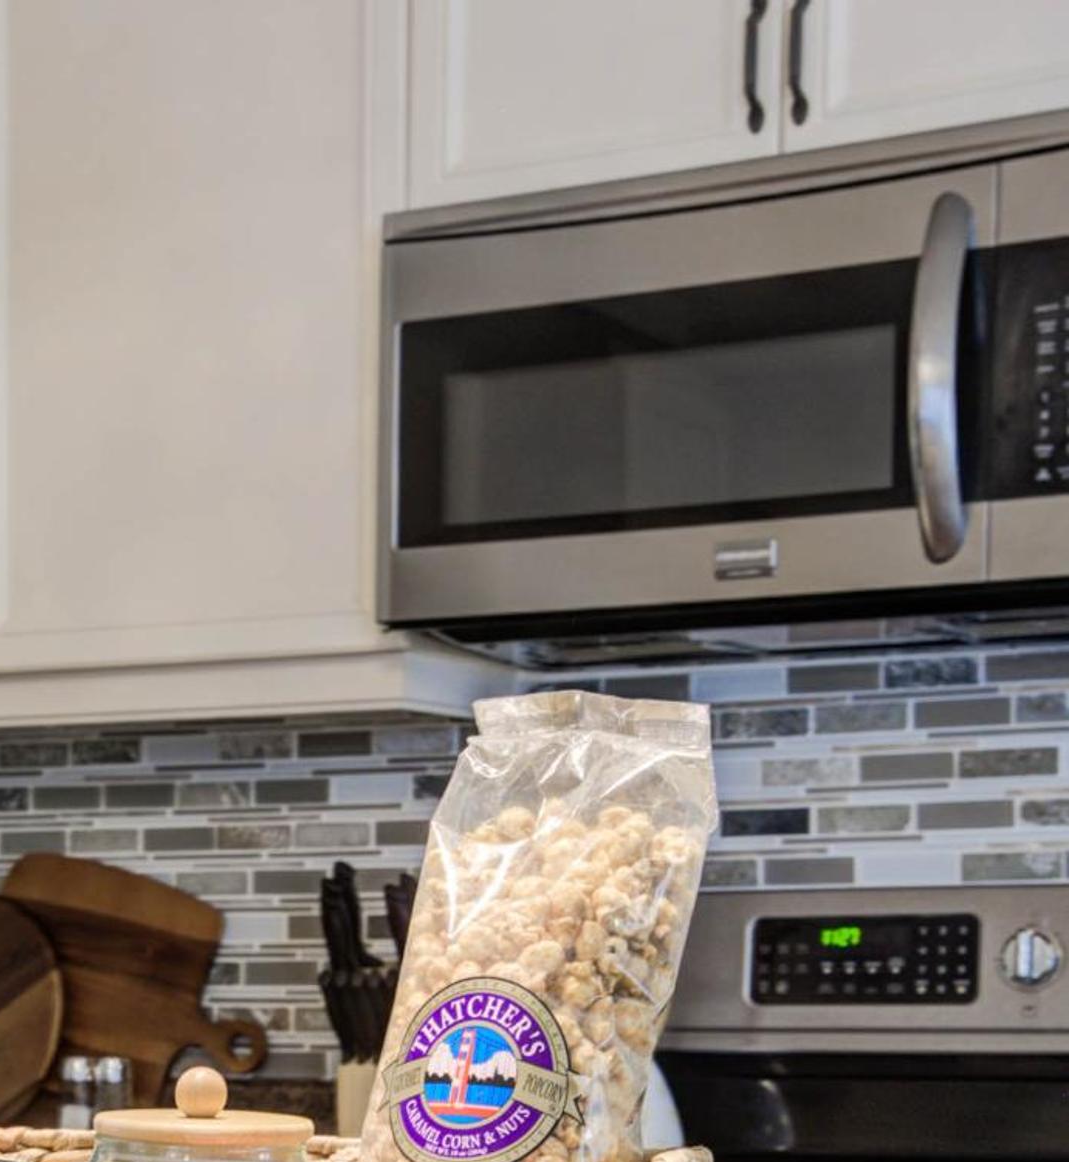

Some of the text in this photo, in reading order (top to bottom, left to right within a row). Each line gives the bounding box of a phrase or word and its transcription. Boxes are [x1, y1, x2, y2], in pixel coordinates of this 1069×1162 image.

[411, 995, 545, 1057] THATCHER'S
[405, 1099, 441, 1145] CARAMEL
[442, 1134, 481, 1150] CORN
[483, 1131, 496, 1145] &
[495, 1105, 531, 1139] NUTS
